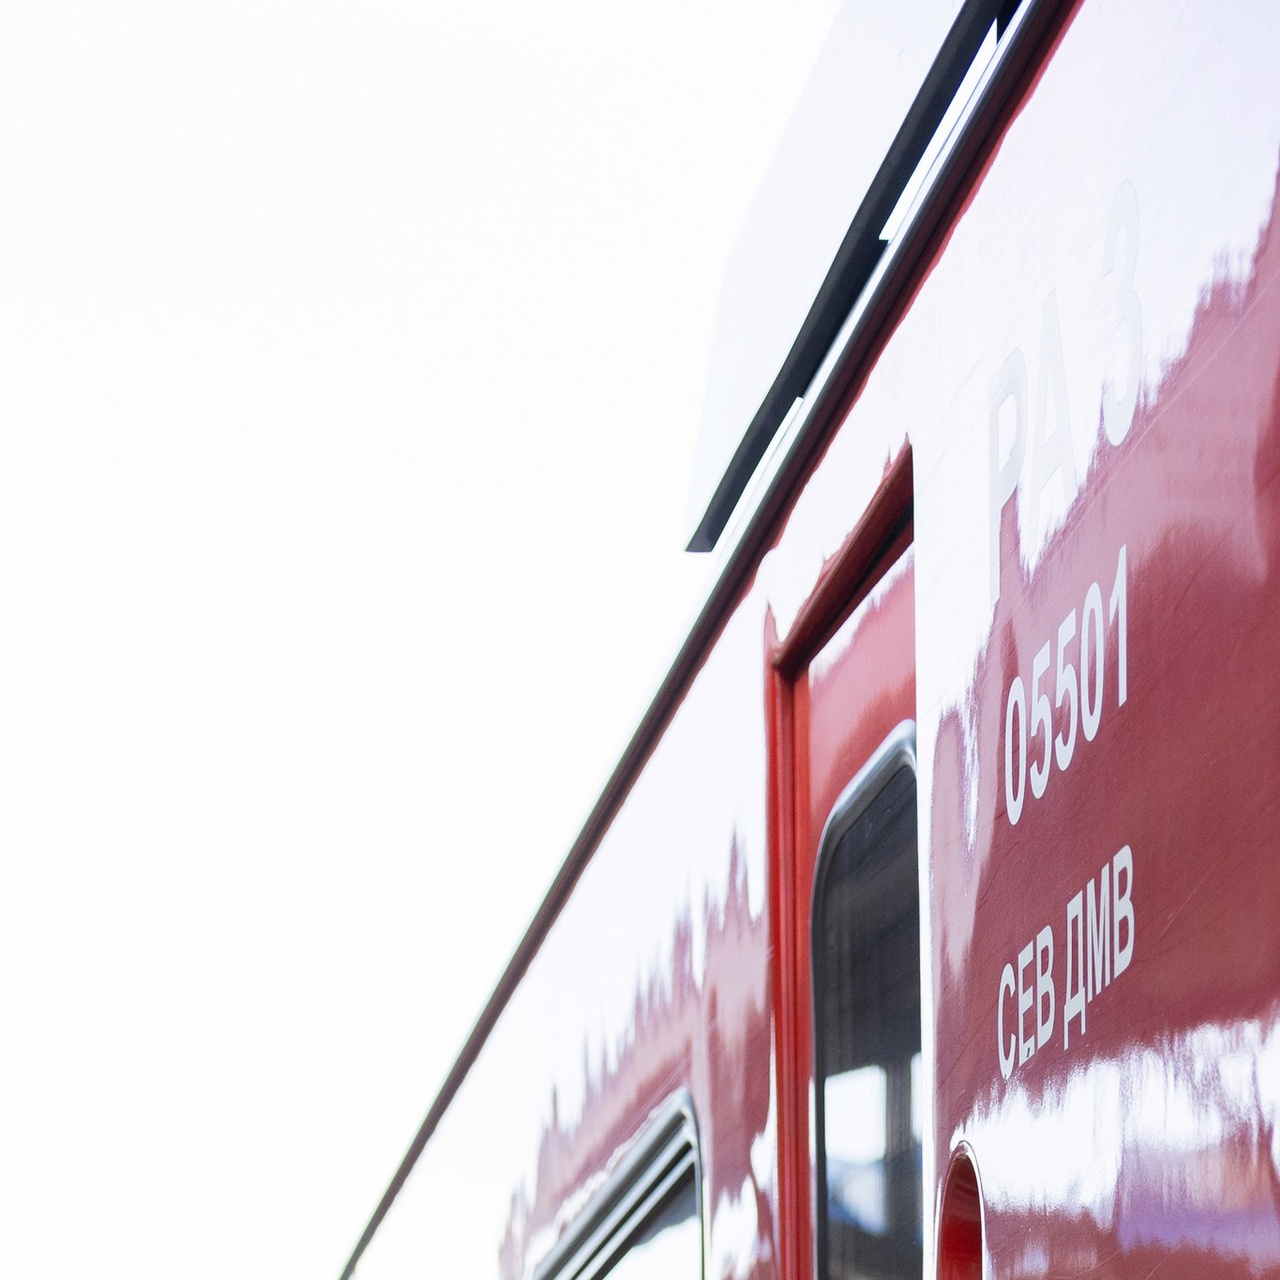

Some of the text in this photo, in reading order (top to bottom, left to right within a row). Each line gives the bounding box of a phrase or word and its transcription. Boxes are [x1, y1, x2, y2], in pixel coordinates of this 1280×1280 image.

[1005, 544, 1127, 825] 05501
[998, 845, 1135, 1080] СЕВ ДМВ
